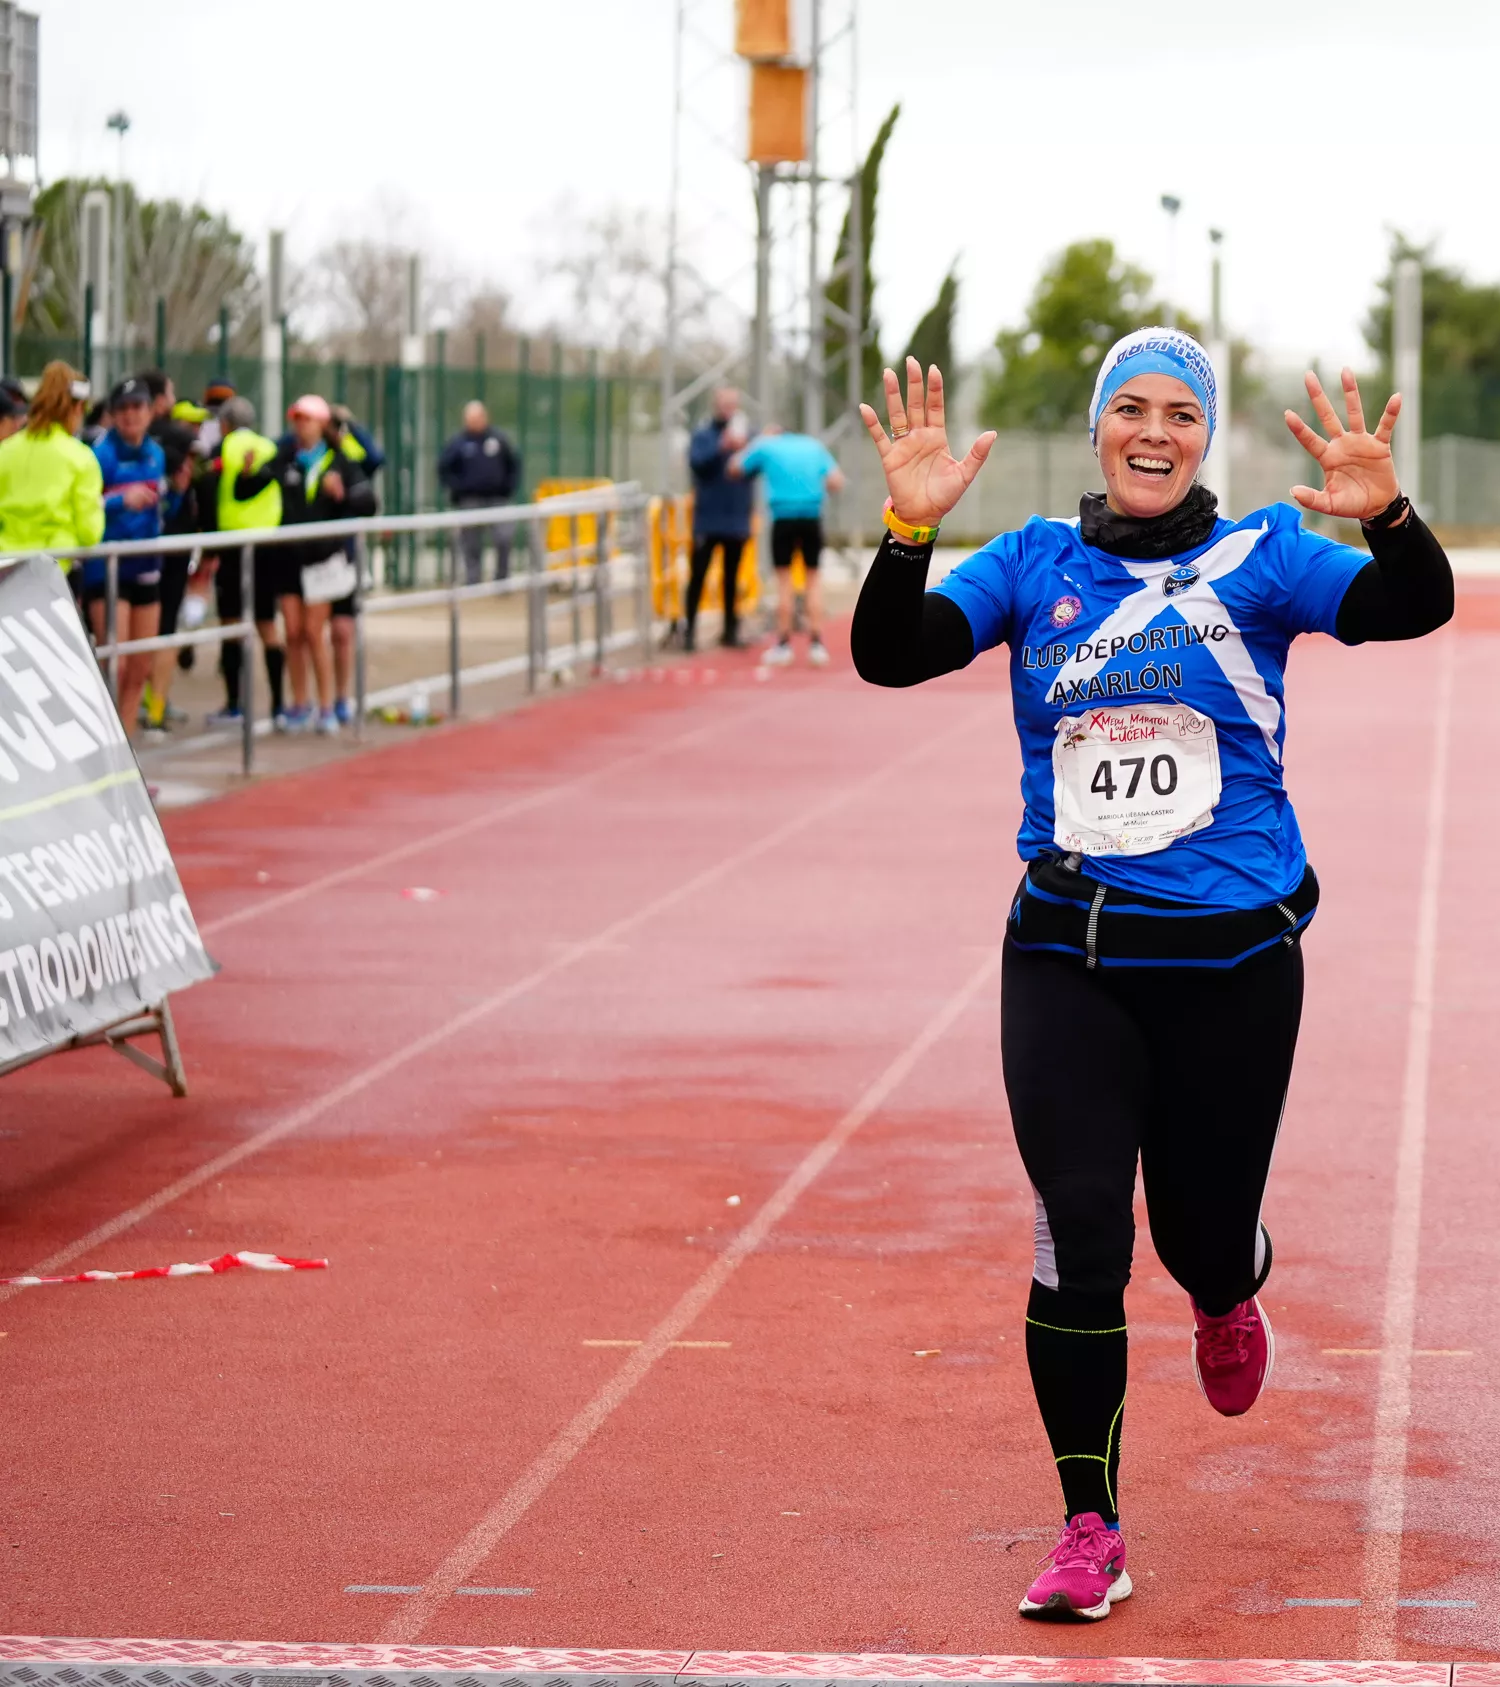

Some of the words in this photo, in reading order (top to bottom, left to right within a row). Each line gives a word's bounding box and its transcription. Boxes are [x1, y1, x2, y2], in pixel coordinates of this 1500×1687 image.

[1074, 624, 1230, 664] DEPORTIVO
[1050, 660, 1182, 706] AXARLÓN
[1110, 727, 1162, 742] LUCENA
[1091, 754, 1178, 801] 470
[1150, 808, 1175, 816] CASTRO
